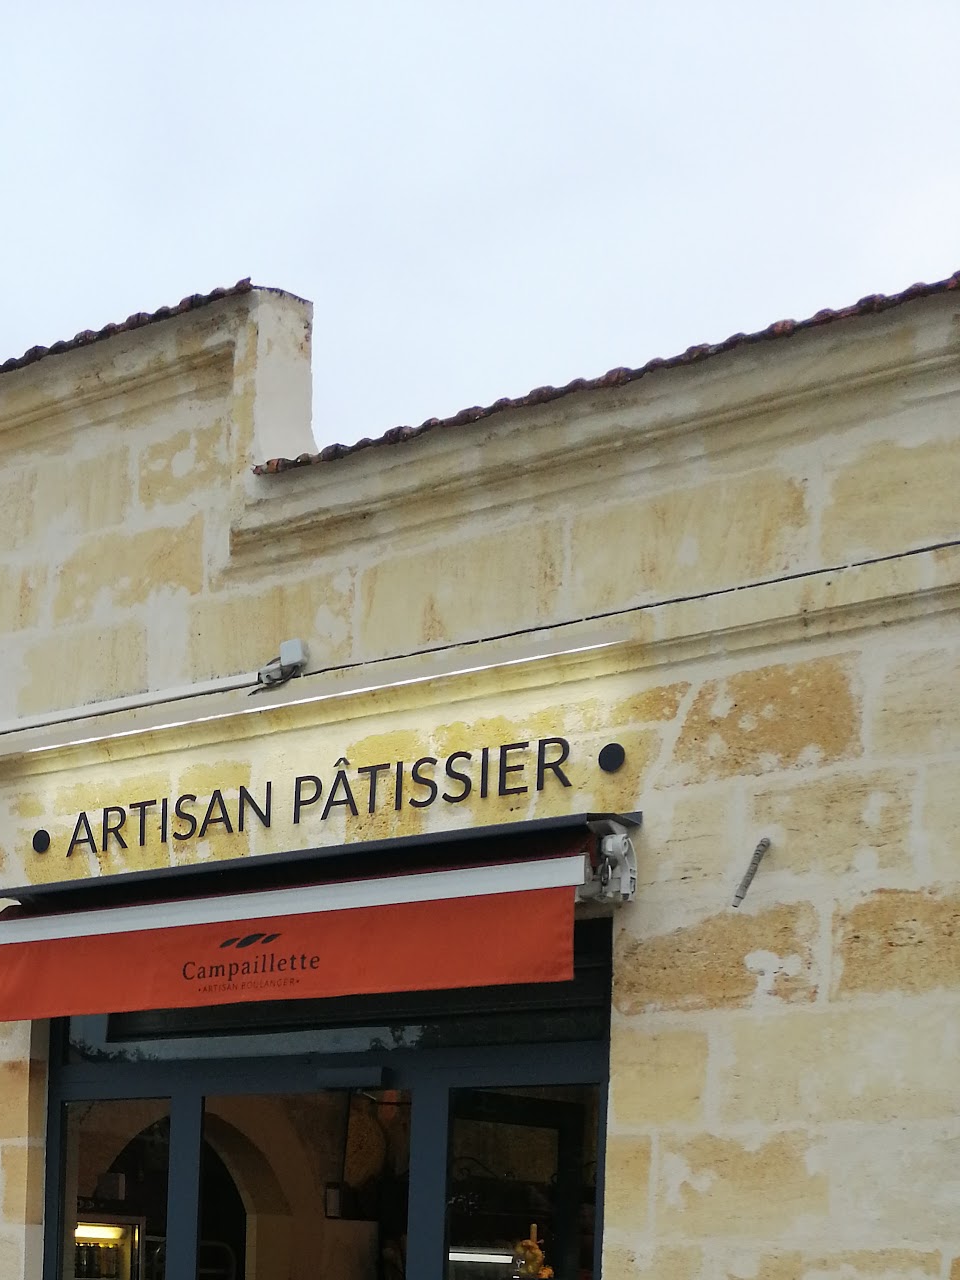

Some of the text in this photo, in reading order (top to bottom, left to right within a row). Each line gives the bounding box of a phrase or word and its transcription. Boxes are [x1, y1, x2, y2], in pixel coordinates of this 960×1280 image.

[65, 737, 573, 858] ARTISAN PÂTISSIER
[182, 953, 320, 982] Campaillette
[202, 978, 296, 993] ARTISAN BOULANGER
